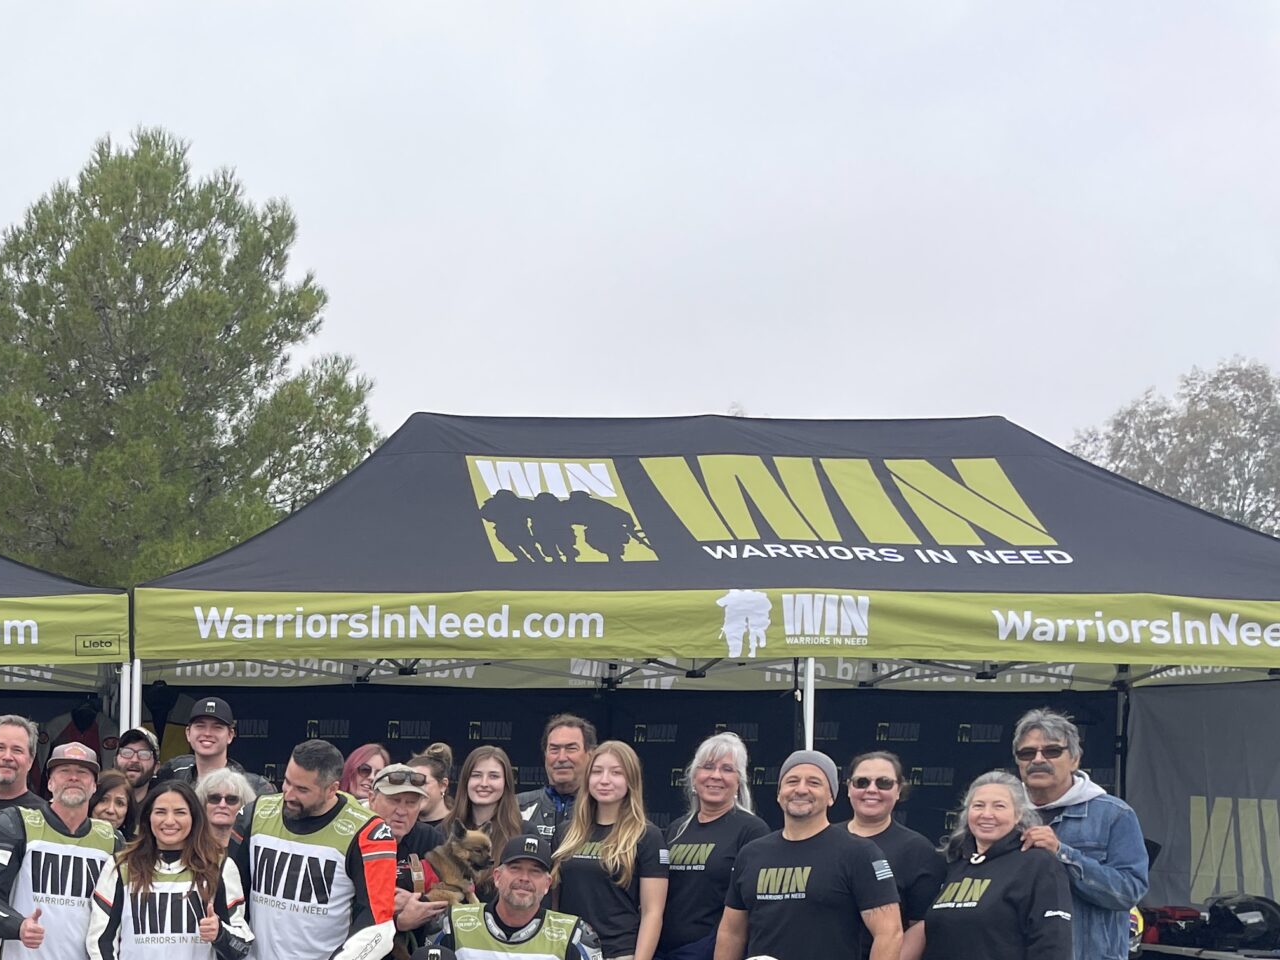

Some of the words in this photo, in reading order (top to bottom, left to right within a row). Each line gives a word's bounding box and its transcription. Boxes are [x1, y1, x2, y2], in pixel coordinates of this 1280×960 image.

[475, 460, 617, 498] WIN
[639, 455, 1058, 545] WIN
[702, 545, 905, 562] WARRIORS
[920, 549, 957, 563] IN
[967, 549, 1074, 564] NEED
[193, 605, 604, 638] WarriorsInNeed.com
[782, 594, 869, 635] WIN
[785, 637, 830, 645] WARRIORS
[833, 637, 842, 645] IN
[844, 637, 867, 645] NEED
[239, 720, 269, 735] WIN
[320, 720, 350, 736] WIN
[400, 720, 431, 736] WIN
[253, 845, 337, 904] WIN
[756, 866, 811, 893] WIN
[33, 895, 75, 907] WARRIORS
[289, 903, 299, 912] IN
[302, 906, 328, 916] NEED
[135, 937, 176, 945] WARRIORS
